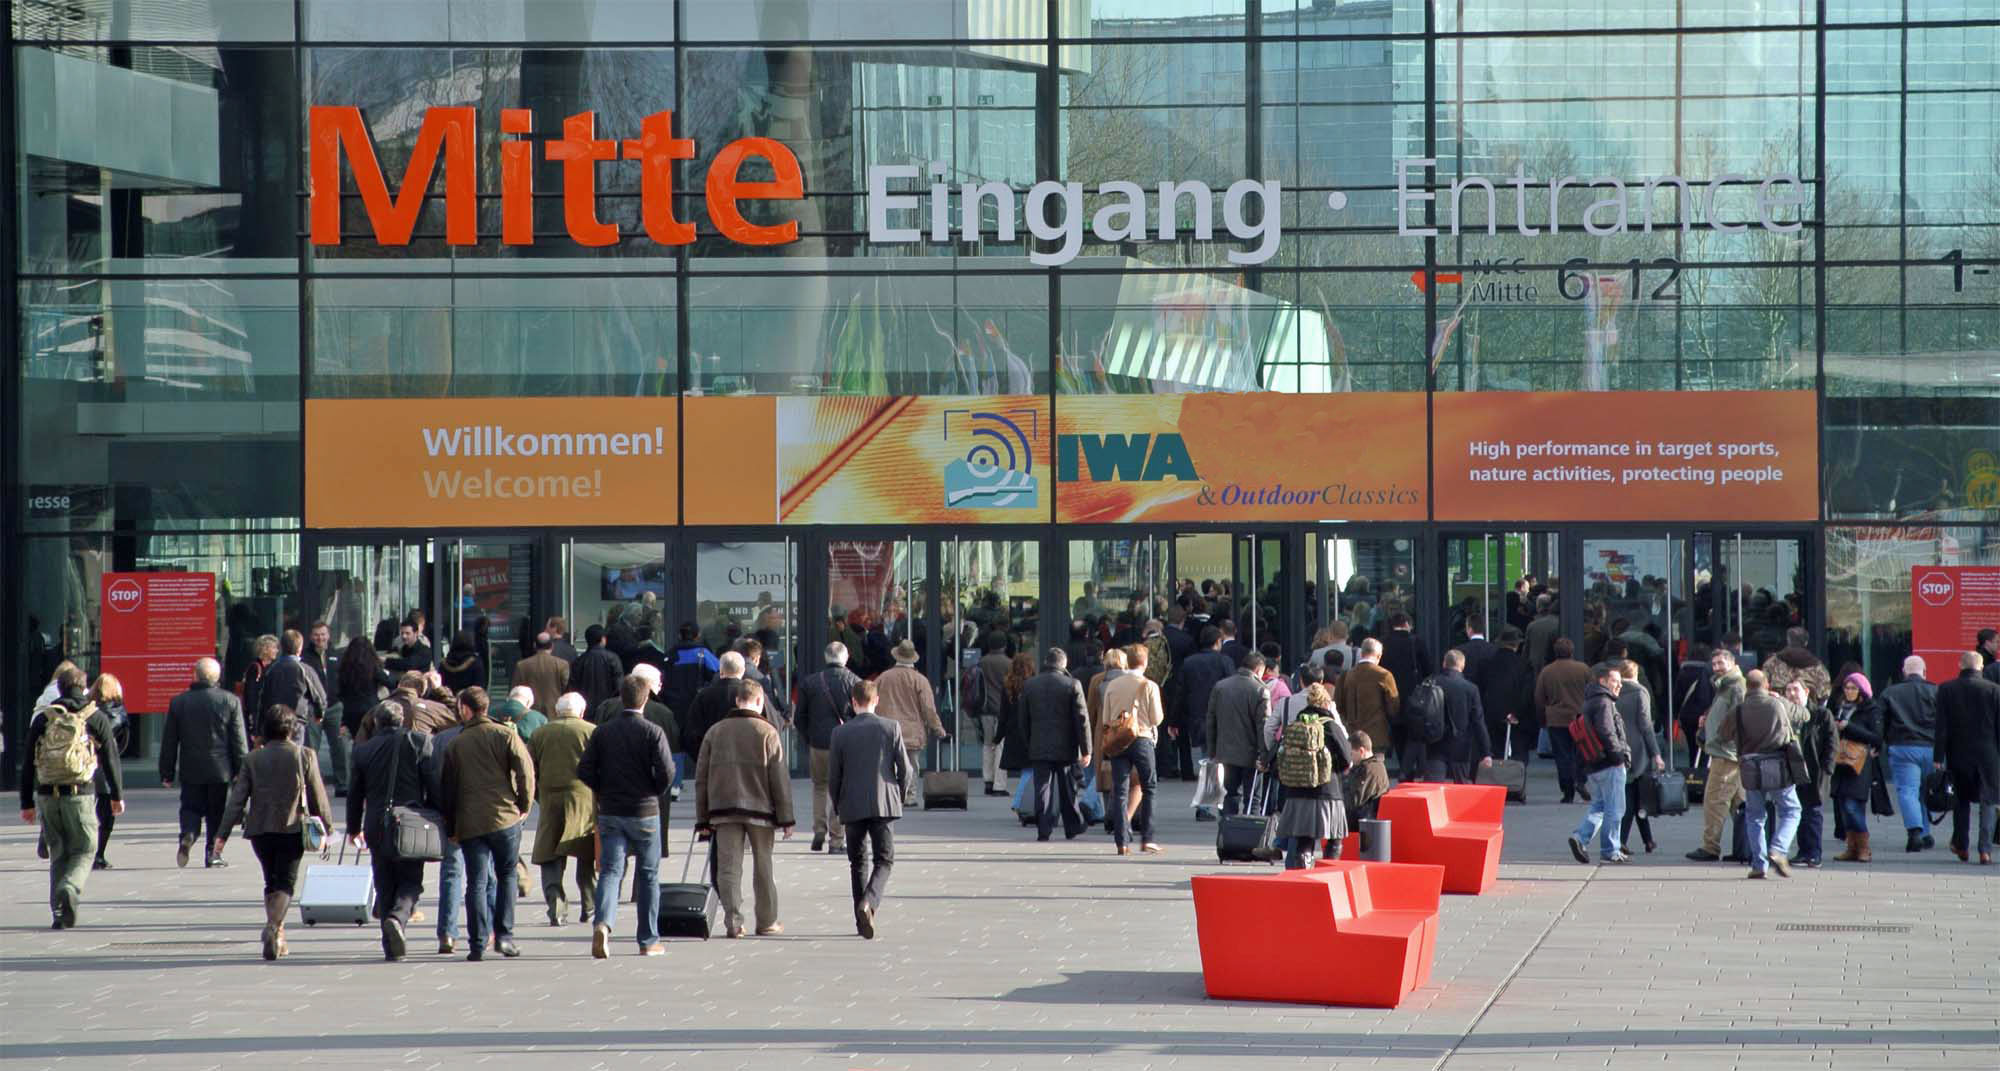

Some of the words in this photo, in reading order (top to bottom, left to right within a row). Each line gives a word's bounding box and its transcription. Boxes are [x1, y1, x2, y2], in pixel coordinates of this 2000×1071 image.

[310, 105, 804, 247] Mitte
[869, 161, 1282, 266] Eingang
[1398, 157, 1802, 238] Entrance
[1471, 281, 1538, 302] Mitte
[422, 425, 664, 457] Willkommen!
[1469, 441, 1511, 459] High
[1516, 440, 1630, 459] performance
[1636, 441, 1652, 457] in
[1658, 442, 1713, 459] target
[1718, 441, 1780, 459] sports,
[1057, 432, 1201, 482] IWA
[423, 467, 602, 499] Welcome!
[1469, 466, 1527, 482] nature
[1532, 465, 1616, 484] activities,
[1622, 465, 1715, 484] protecting
[1721, 465, 1783, 485] people
[1196, 484, 1217, 507] &
[1220, 482, 1420, 507] OutdoorClassics
[111, 591, 139, 601] STOP
[1921, 583, 1951, 595] STOP
